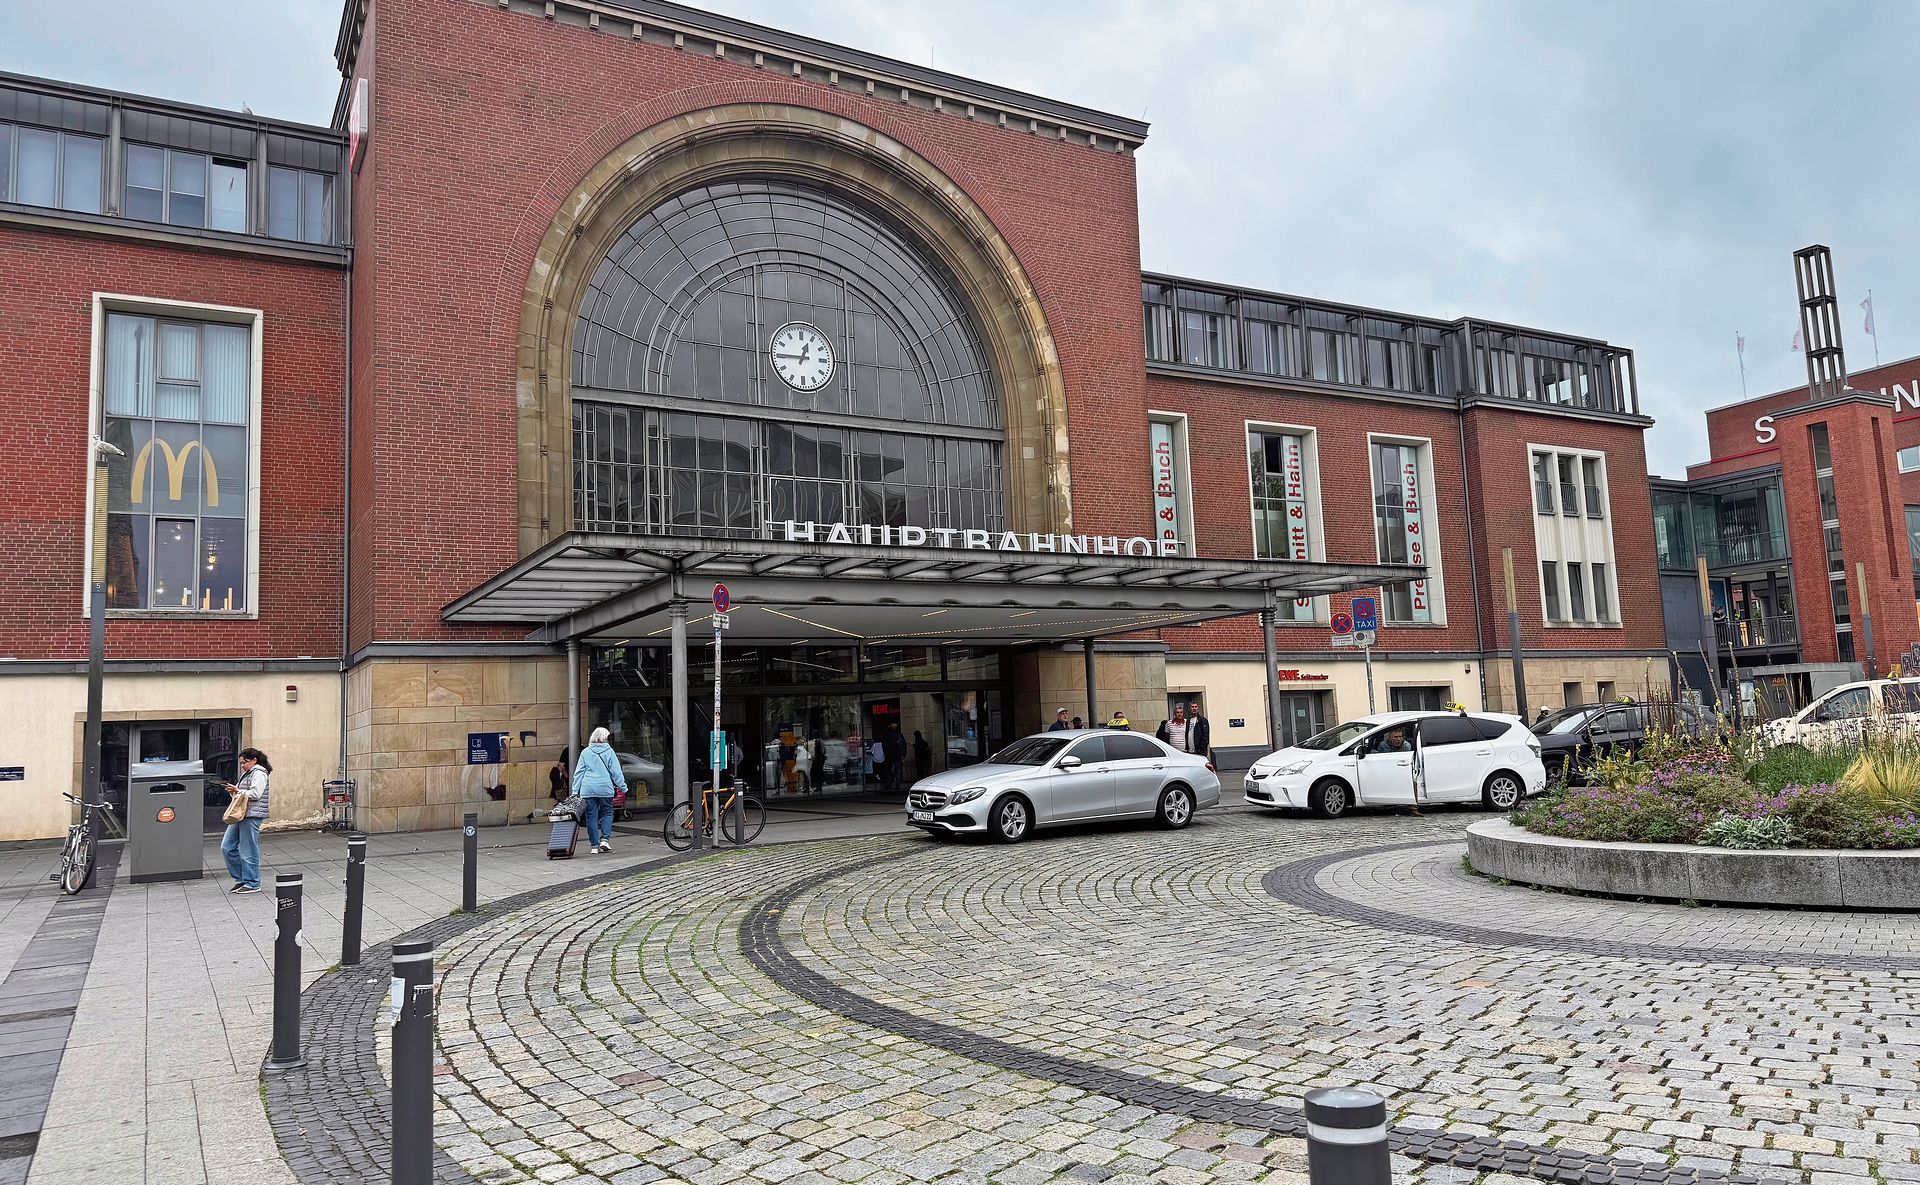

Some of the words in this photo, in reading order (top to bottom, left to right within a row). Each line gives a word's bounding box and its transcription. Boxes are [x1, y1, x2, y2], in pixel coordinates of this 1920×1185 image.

[1156, 442, 1172, 498] Buch
[1287, 444, 1301, 498] Hahn
[1403, 463, 1418, 513] Buch
[1290, 505, 1303, 519] &
[1408, 521, 1419, 535] &
[785, 519, 1178, 557] HAUPTBAHNHOF
[1411, 541, 1426, 610] Prese
[1356, 620, 1375, 629] TAXI
[1277, 669, 1300, 680] EWE
